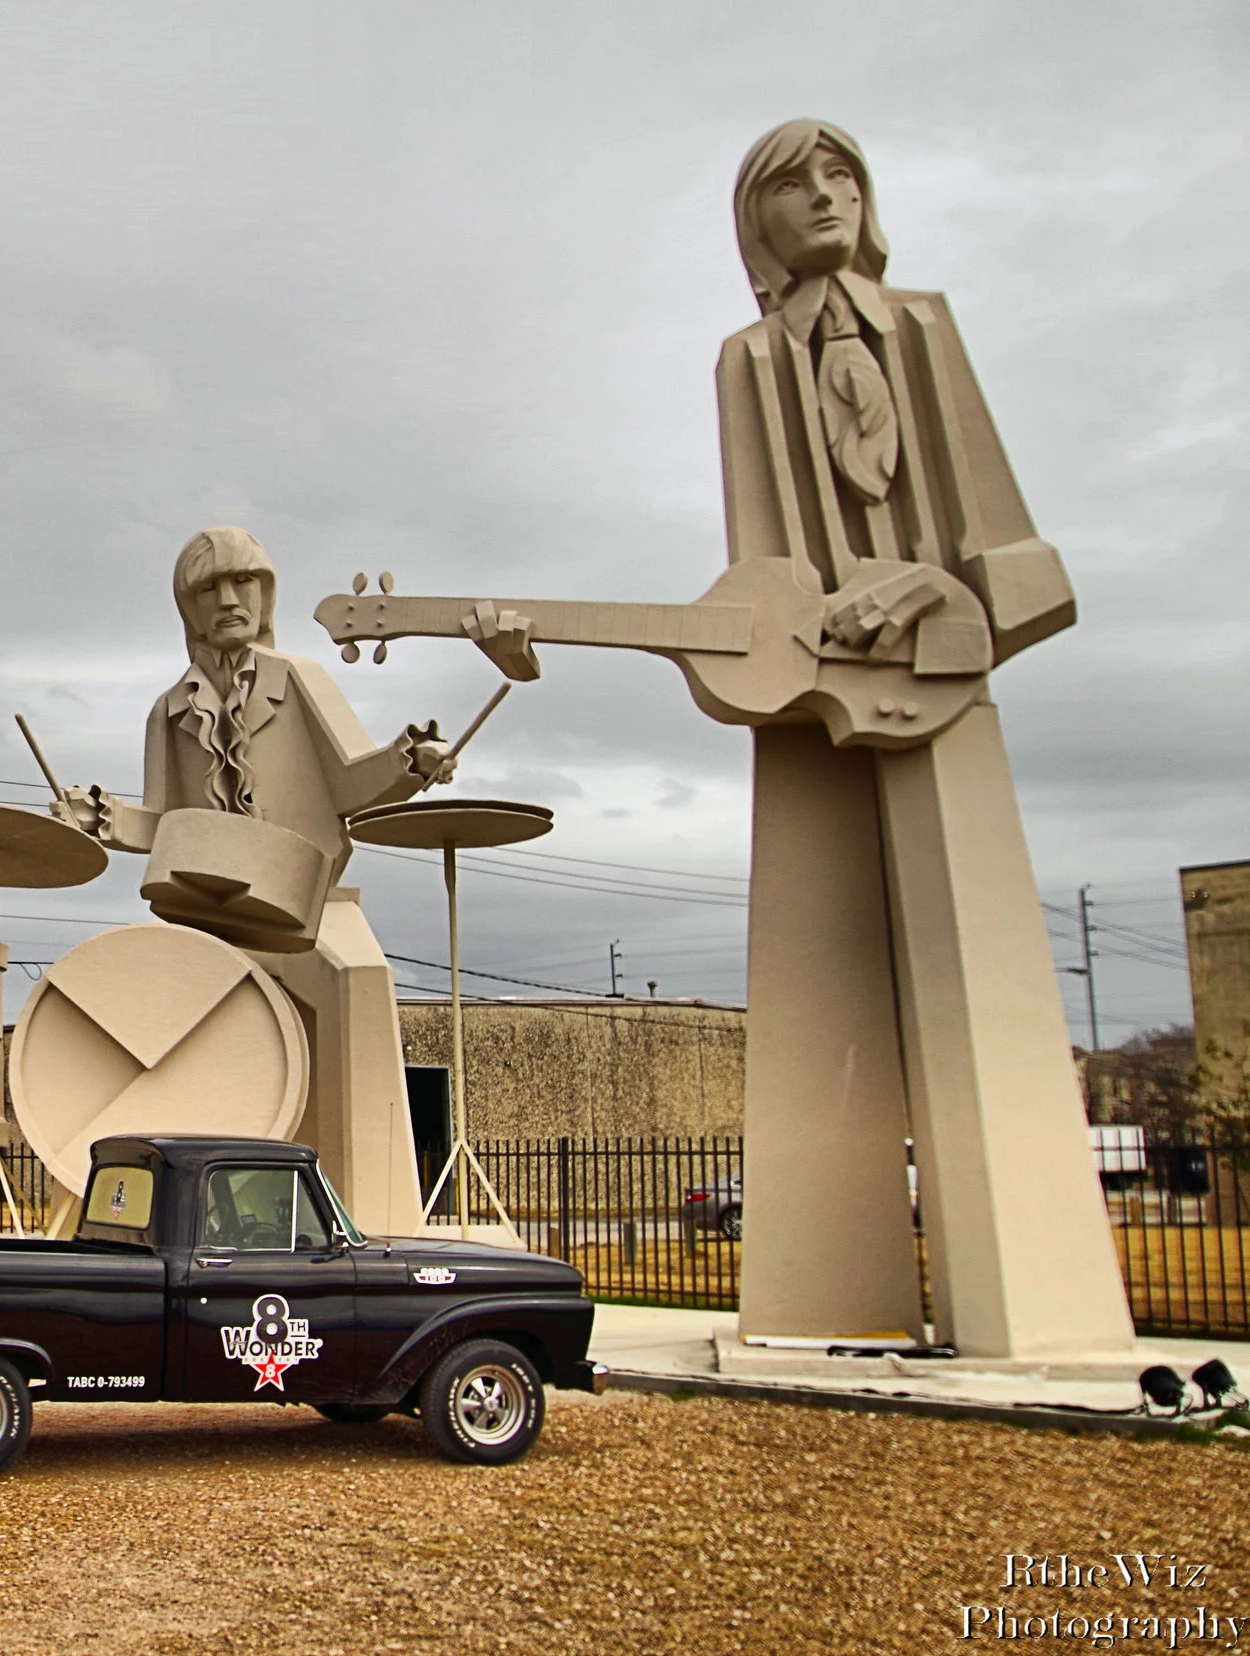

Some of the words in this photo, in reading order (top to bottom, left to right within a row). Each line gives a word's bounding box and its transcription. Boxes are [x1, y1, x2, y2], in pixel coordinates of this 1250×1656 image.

[223, 1329, 316, 1357] WONDER
[264, 1363, 278, 1378] 8
[66, 1376, 96, 1388] TABC
